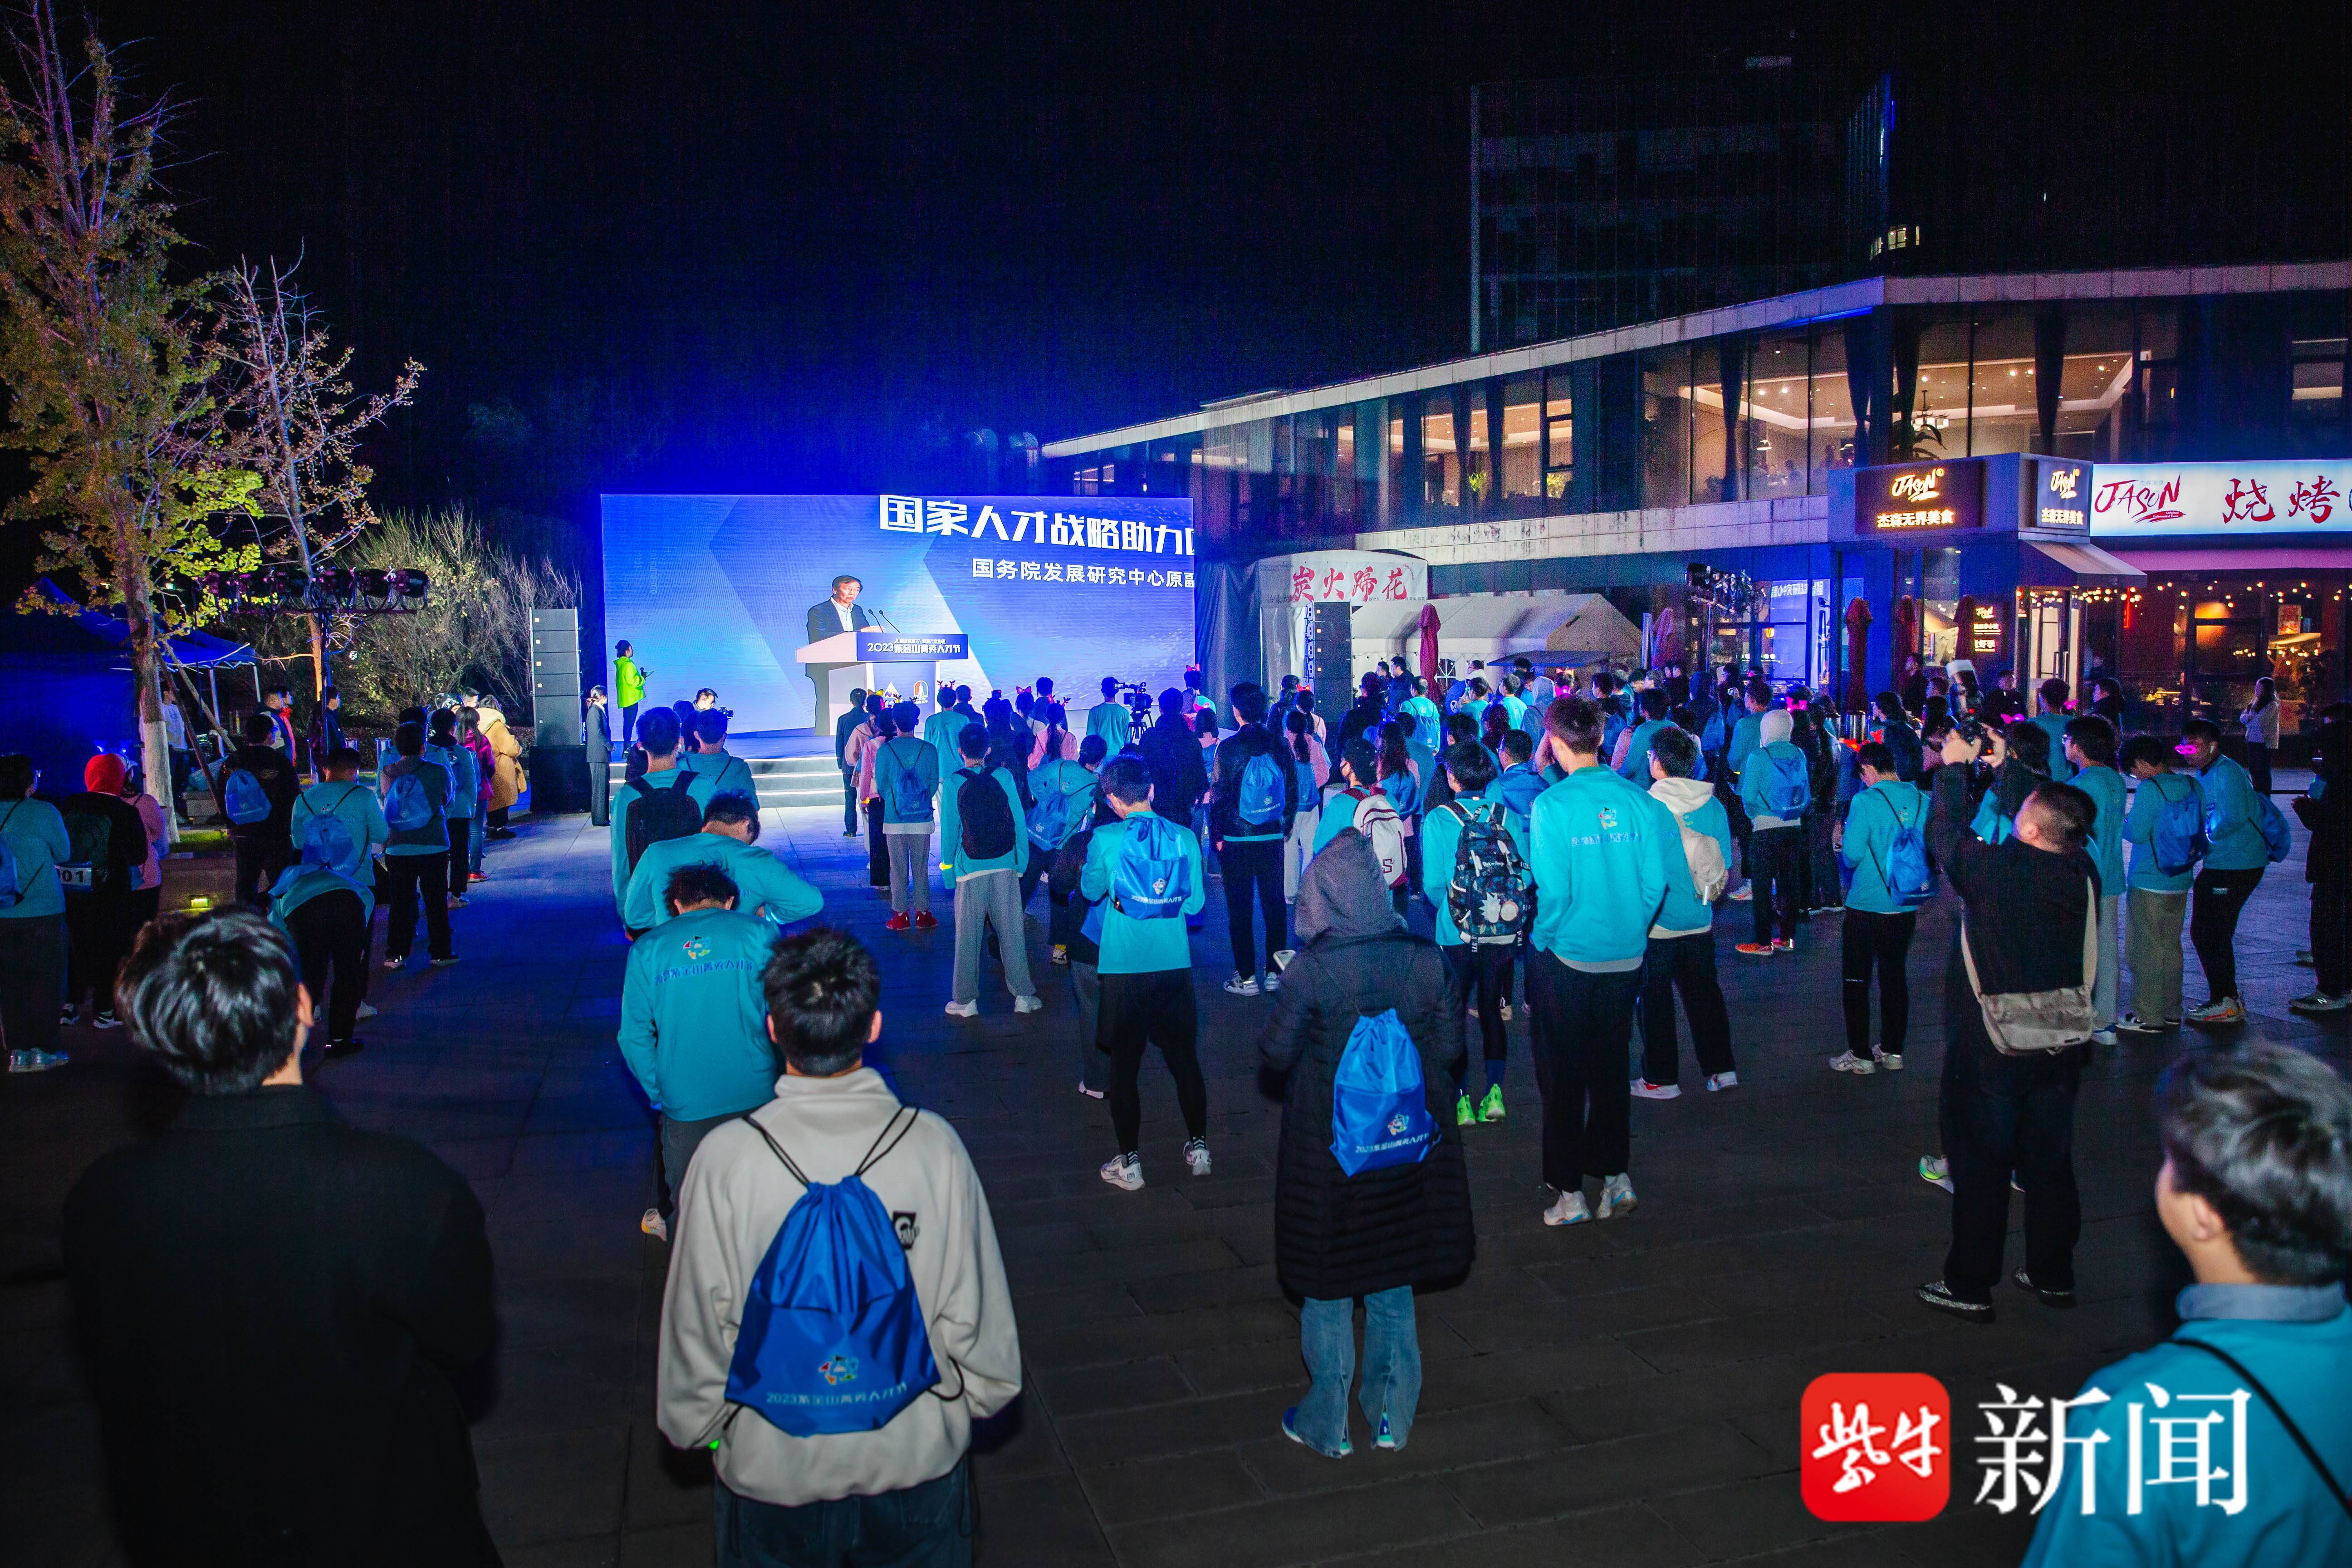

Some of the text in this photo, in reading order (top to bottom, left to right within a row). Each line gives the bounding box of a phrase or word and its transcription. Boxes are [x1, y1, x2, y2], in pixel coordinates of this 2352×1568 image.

[2094, 472, 2181, 519] JASON
[2222, 475, 2340, 524] 烧烤
[1877, 509, 1954, 528] 杰森无界美食
[2041, 508, 2083, 525] 杰森无界美食
[1289, 566, 1406, 603] 炭火蹄花
